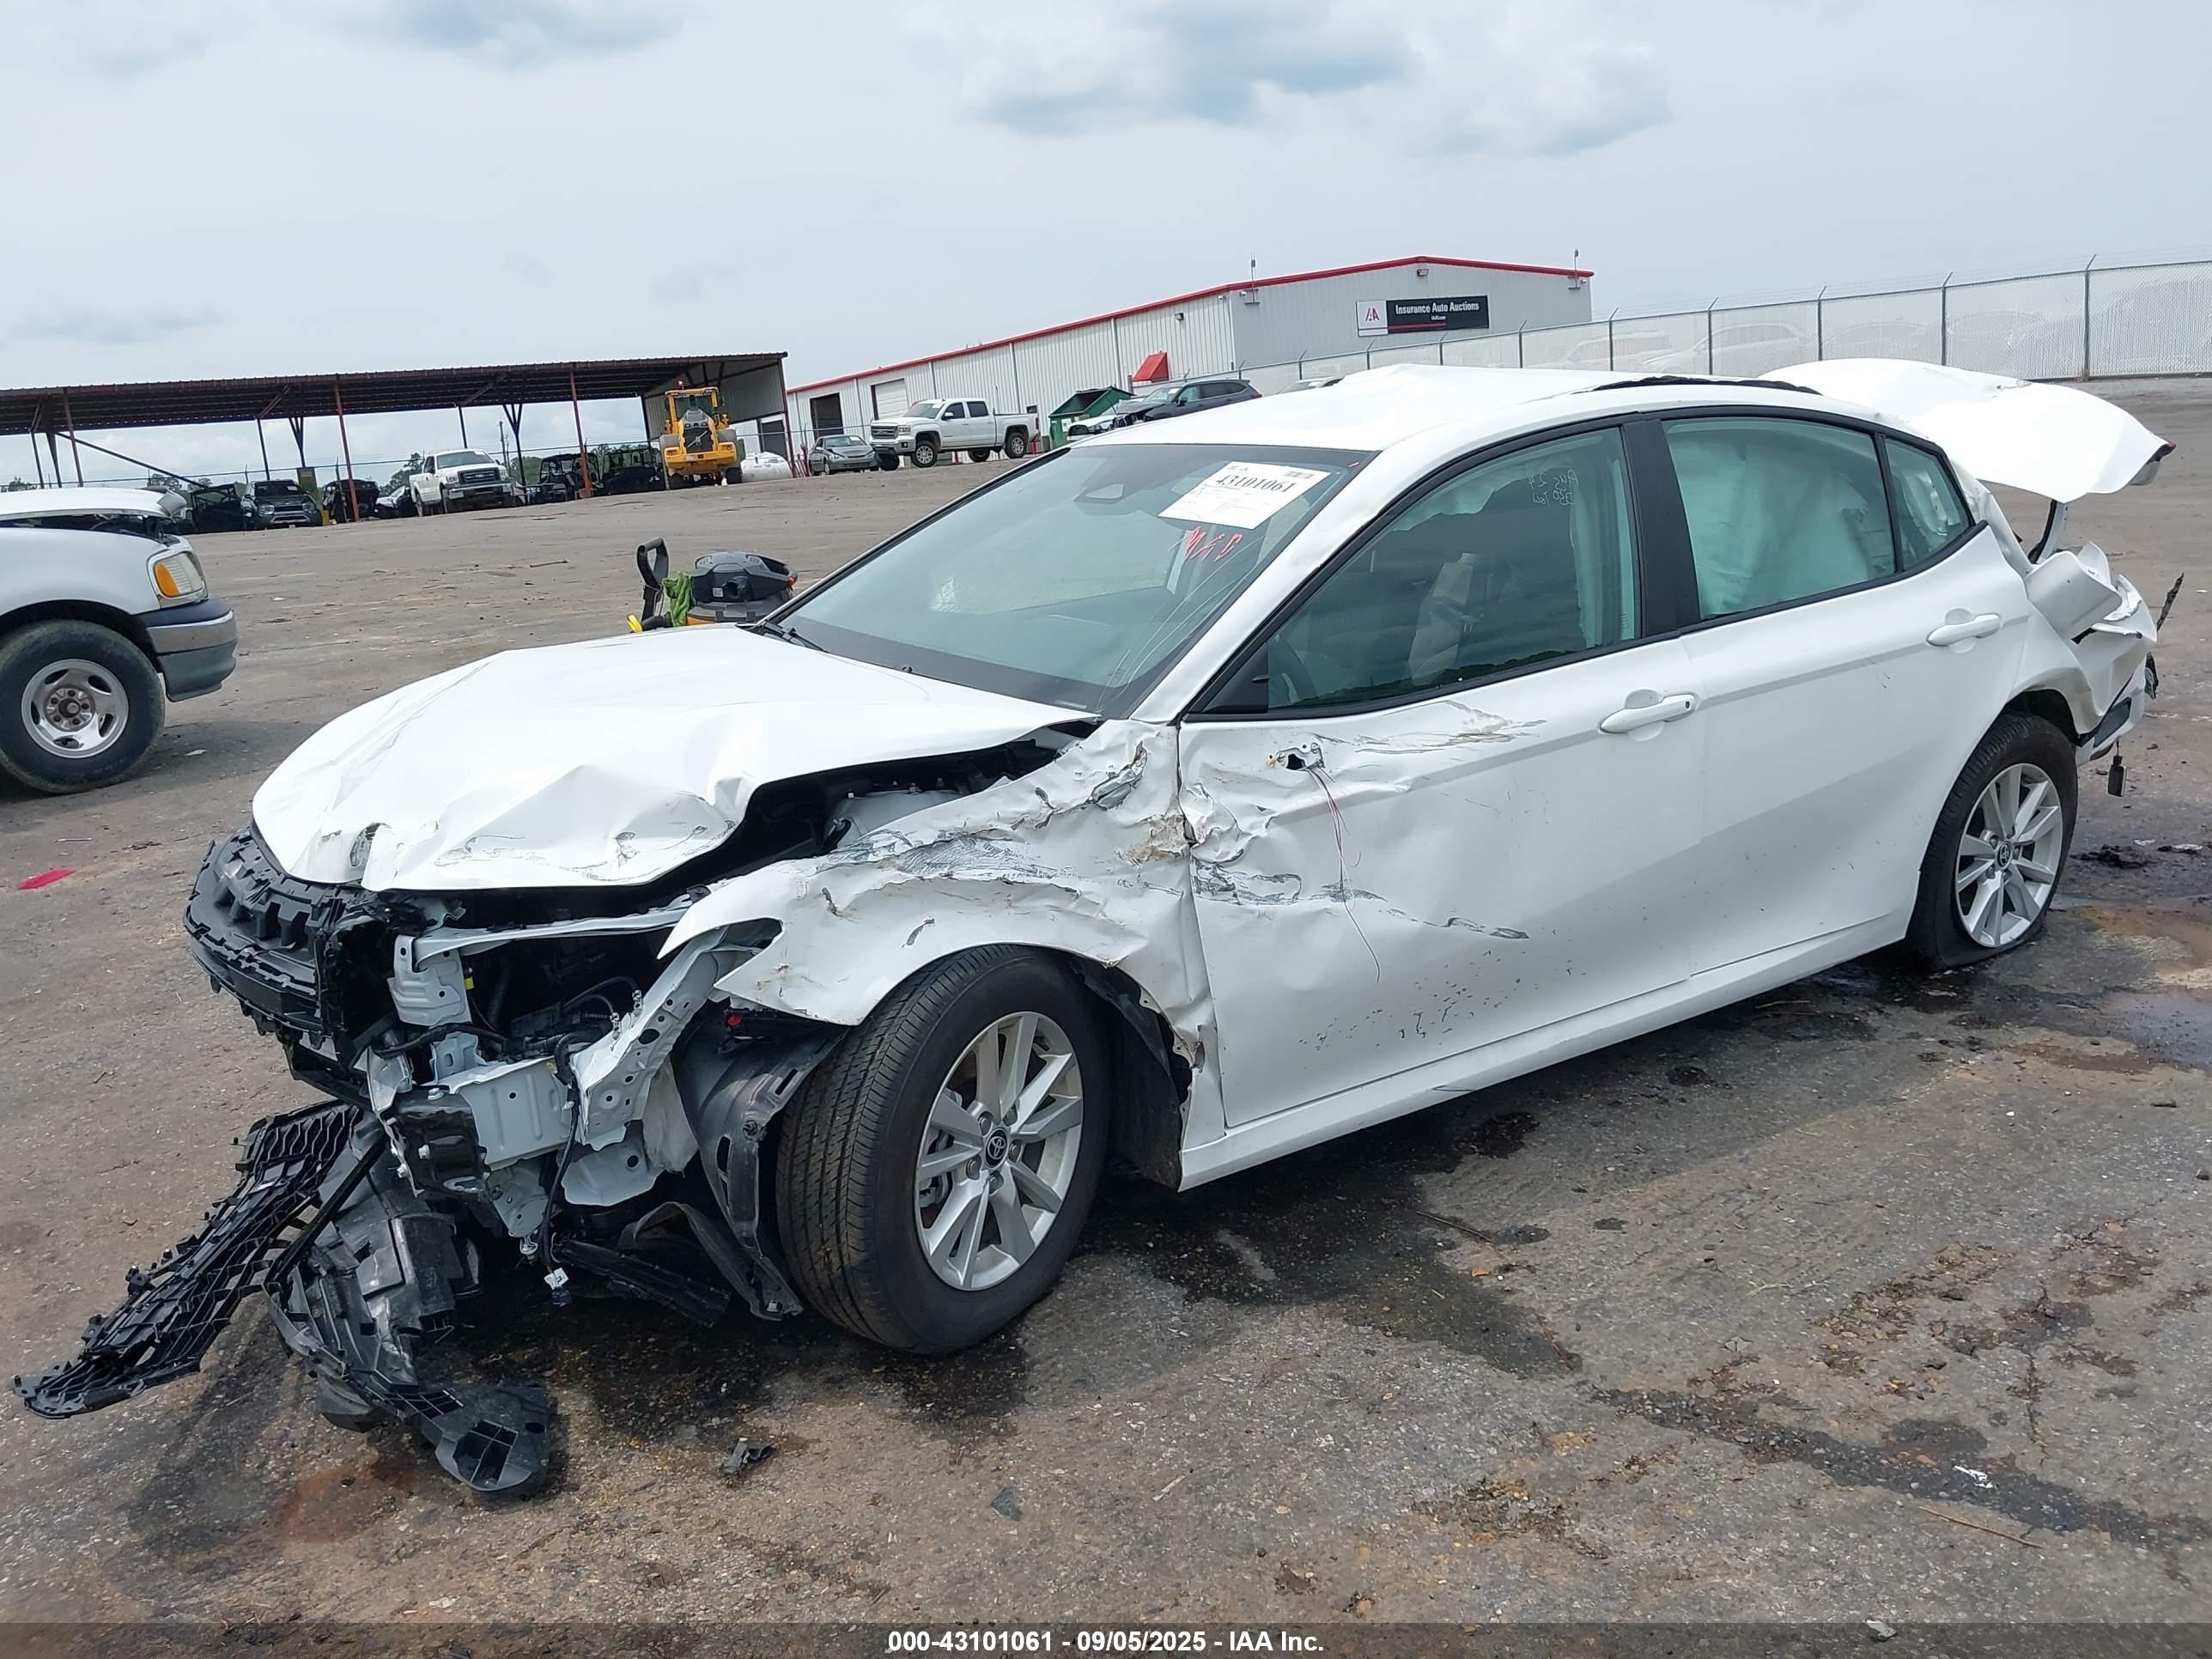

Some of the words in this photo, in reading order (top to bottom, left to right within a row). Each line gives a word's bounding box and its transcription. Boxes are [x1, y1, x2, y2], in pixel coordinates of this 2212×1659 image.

[1395, 303, 1431, 314] Insurance
[1431, 302, 1449, 313] Auto
[1449, 301, 1480, 312] Auctions
[1216, 474, 1297, 493] 43101061
